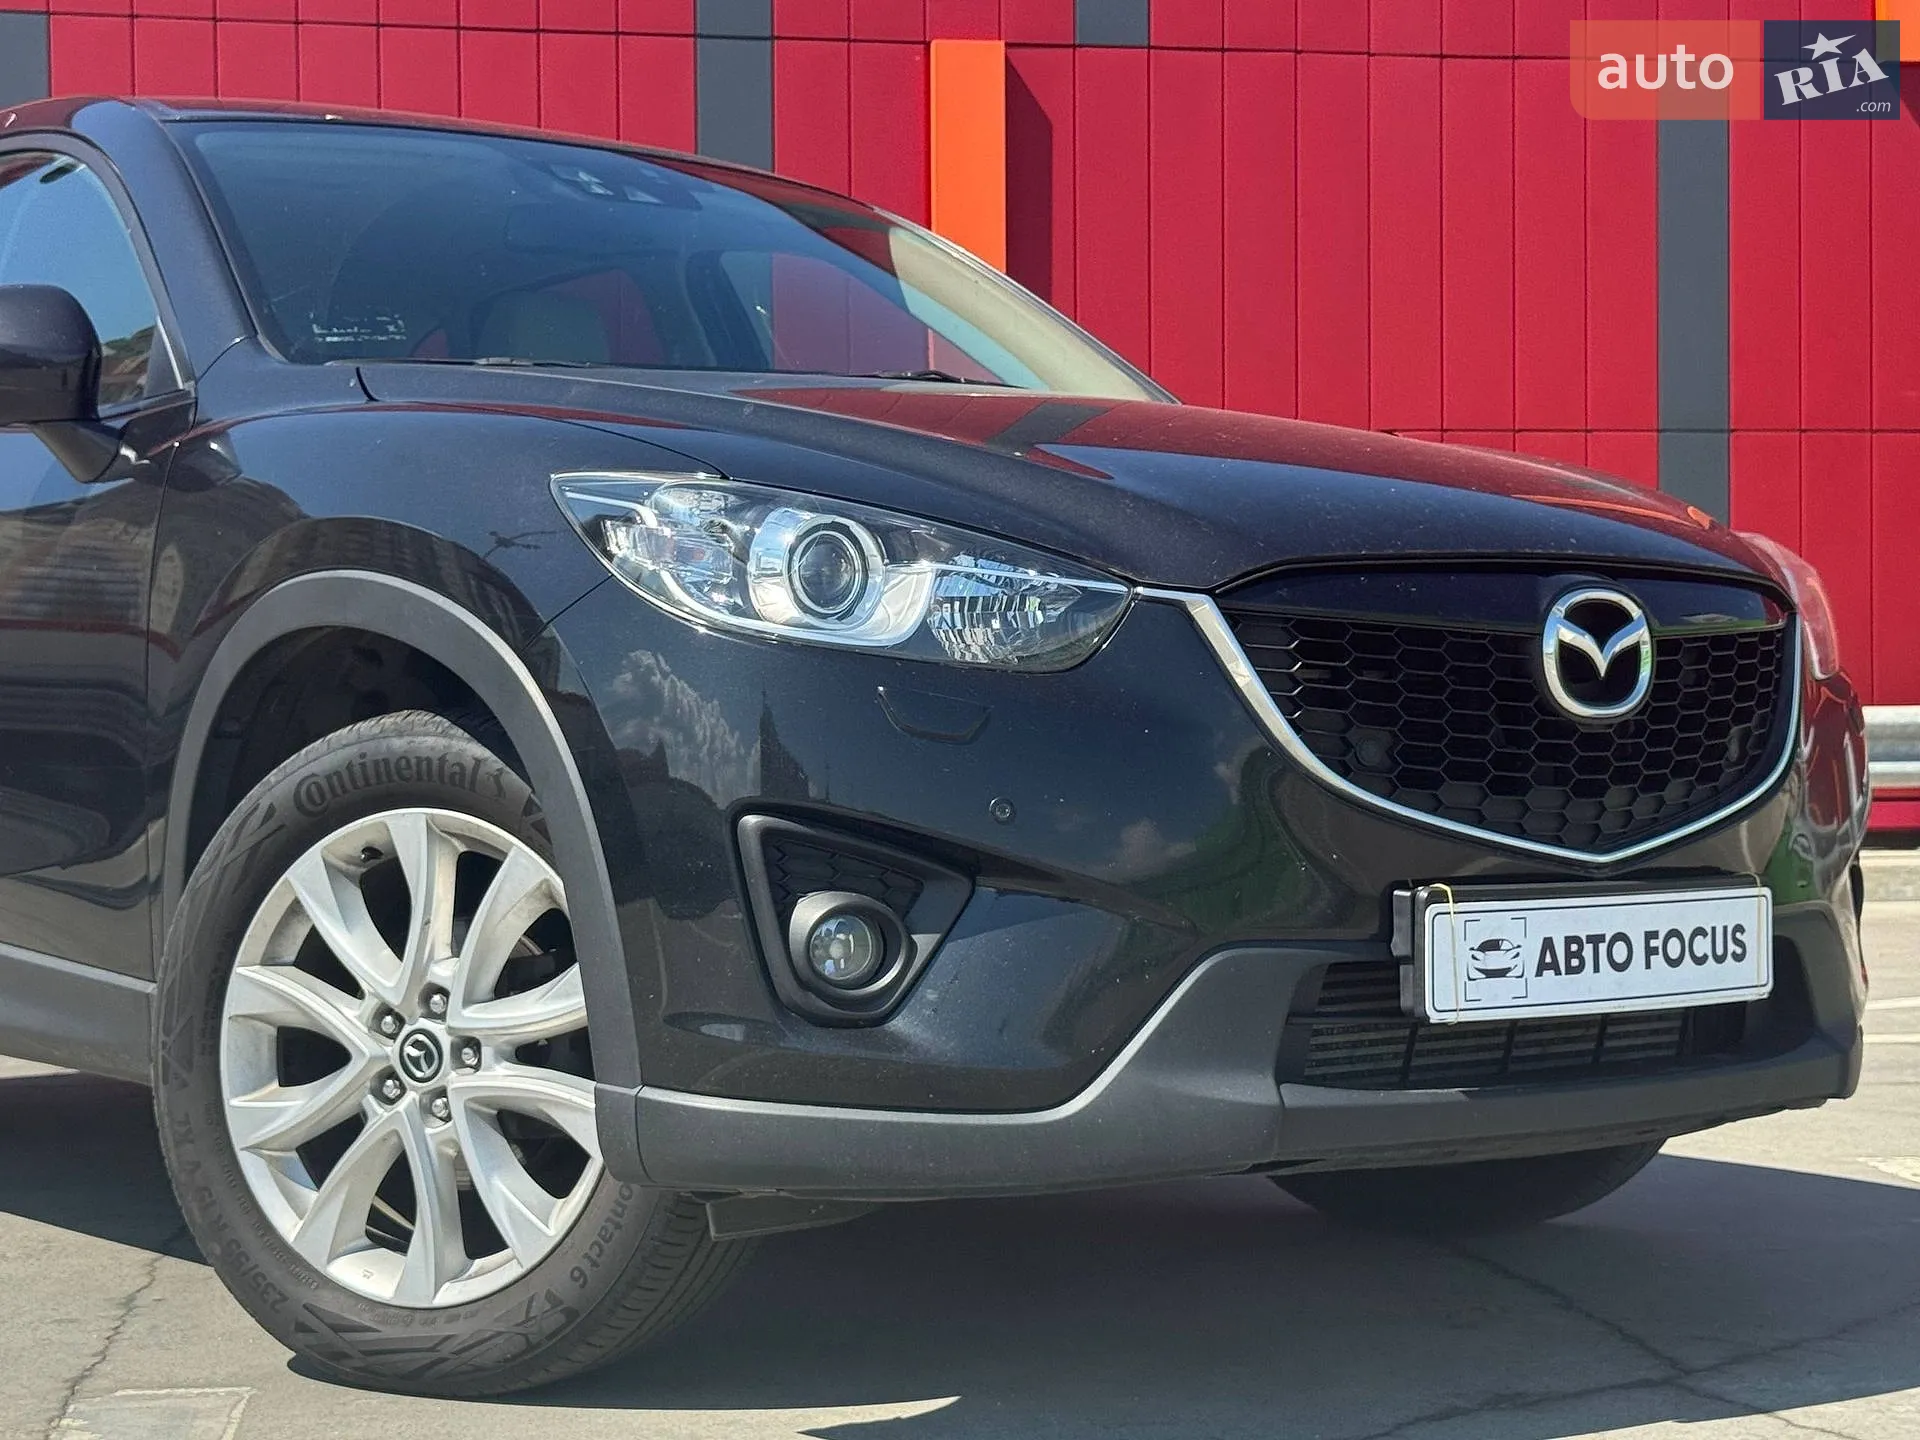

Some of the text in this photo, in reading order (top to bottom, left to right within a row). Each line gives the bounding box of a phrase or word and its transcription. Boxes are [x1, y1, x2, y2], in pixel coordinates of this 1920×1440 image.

[293, 751, 486, 818] Continental
[1644, 922, 1748, 970] FOCUS
[570, 1183, 634, 1289] ontact 6
[225, 1237, 291, 1314] 235/55
